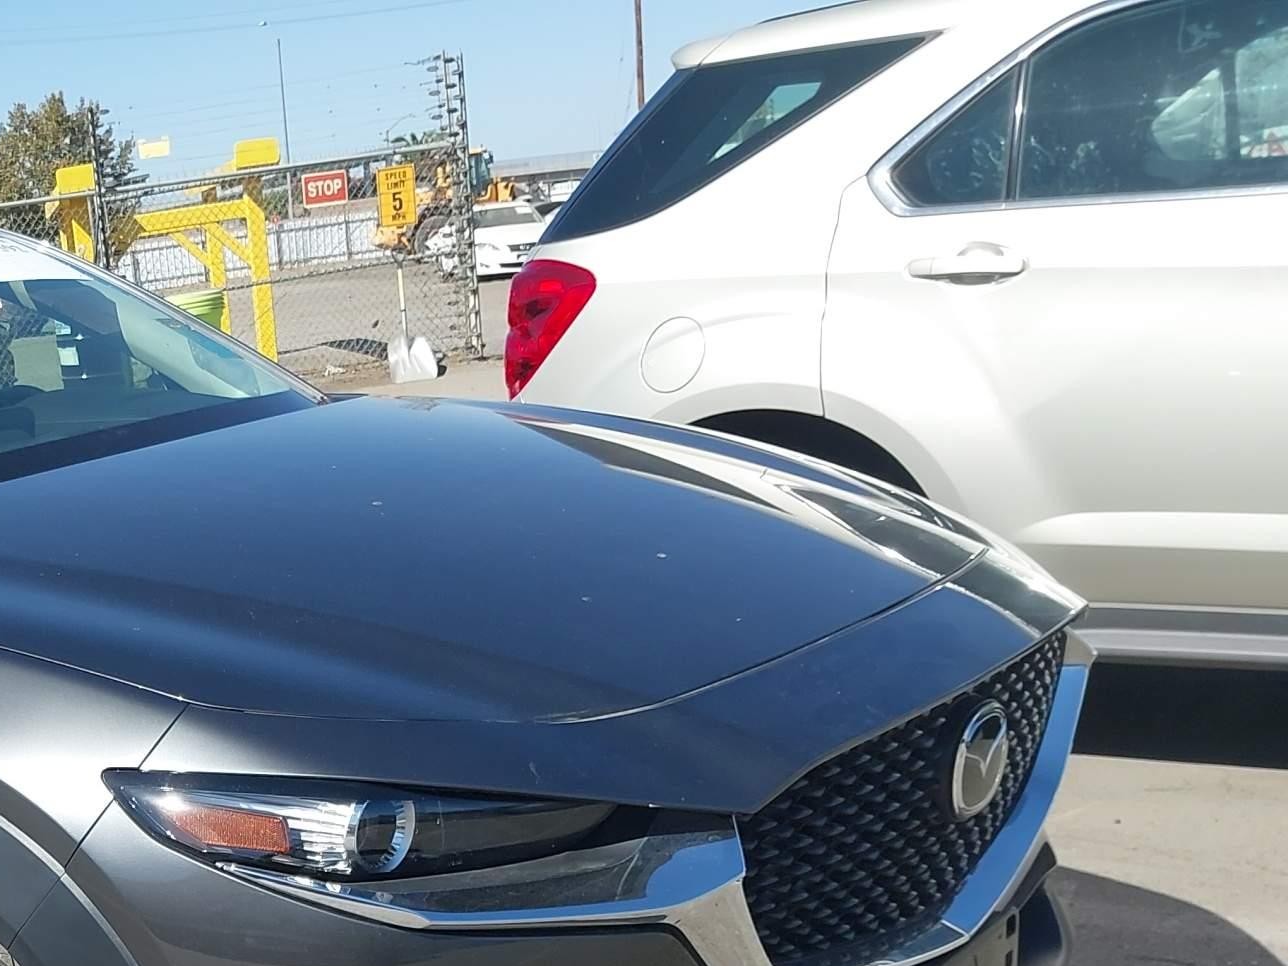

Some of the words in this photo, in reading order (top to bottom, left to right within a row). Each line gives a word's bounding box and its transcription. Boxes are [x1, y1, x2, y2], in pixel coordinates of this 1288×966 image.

[385, 170, 407, 181] SPEED
[307, 178, 343, 198] STOP
[386, 180, 406, 191] LIMIT
[392, 191, 404, 212] 5
[392, 212, 407, 222] MPH
